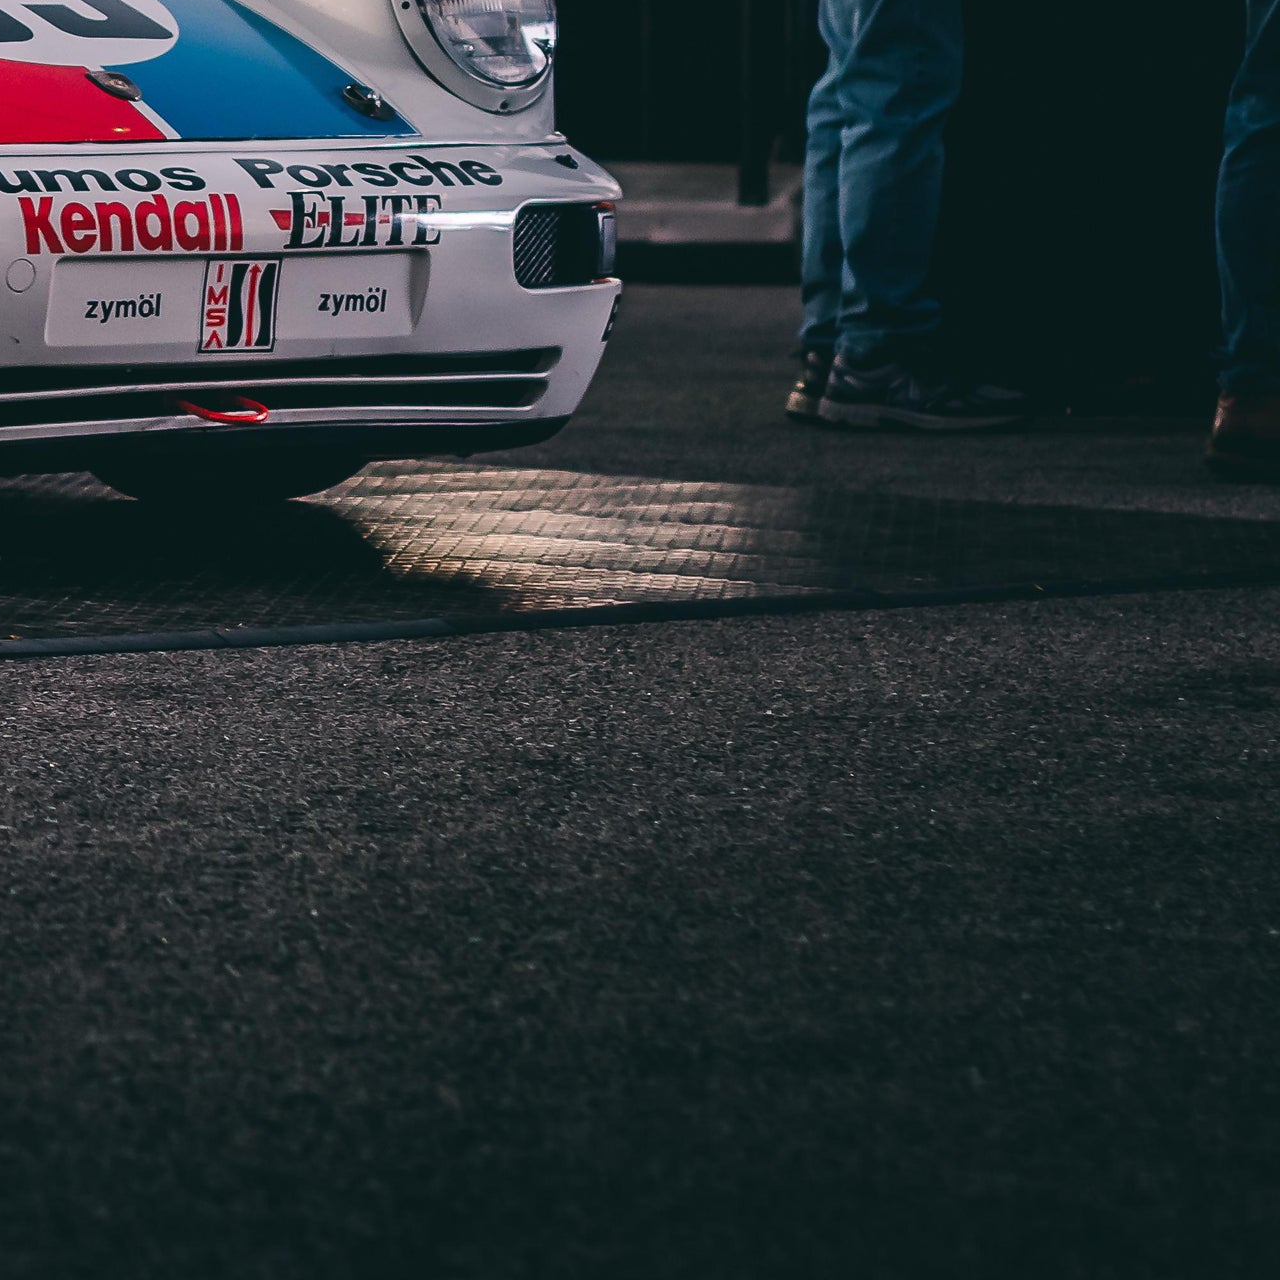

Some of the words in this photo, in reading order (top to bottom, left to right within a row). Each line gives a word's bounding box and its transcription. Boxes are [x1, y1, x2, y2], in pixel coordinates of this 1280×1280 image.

[232, 154, 504, 189] Porsche
[17, 193, 244, 255] Kendall
[282, 191, 443, 249] ELITE
[84, 293, 162, 324] zymöl
[204, 263, 229, 350] IMSA
[317, 287, 388, 317] zymöl
